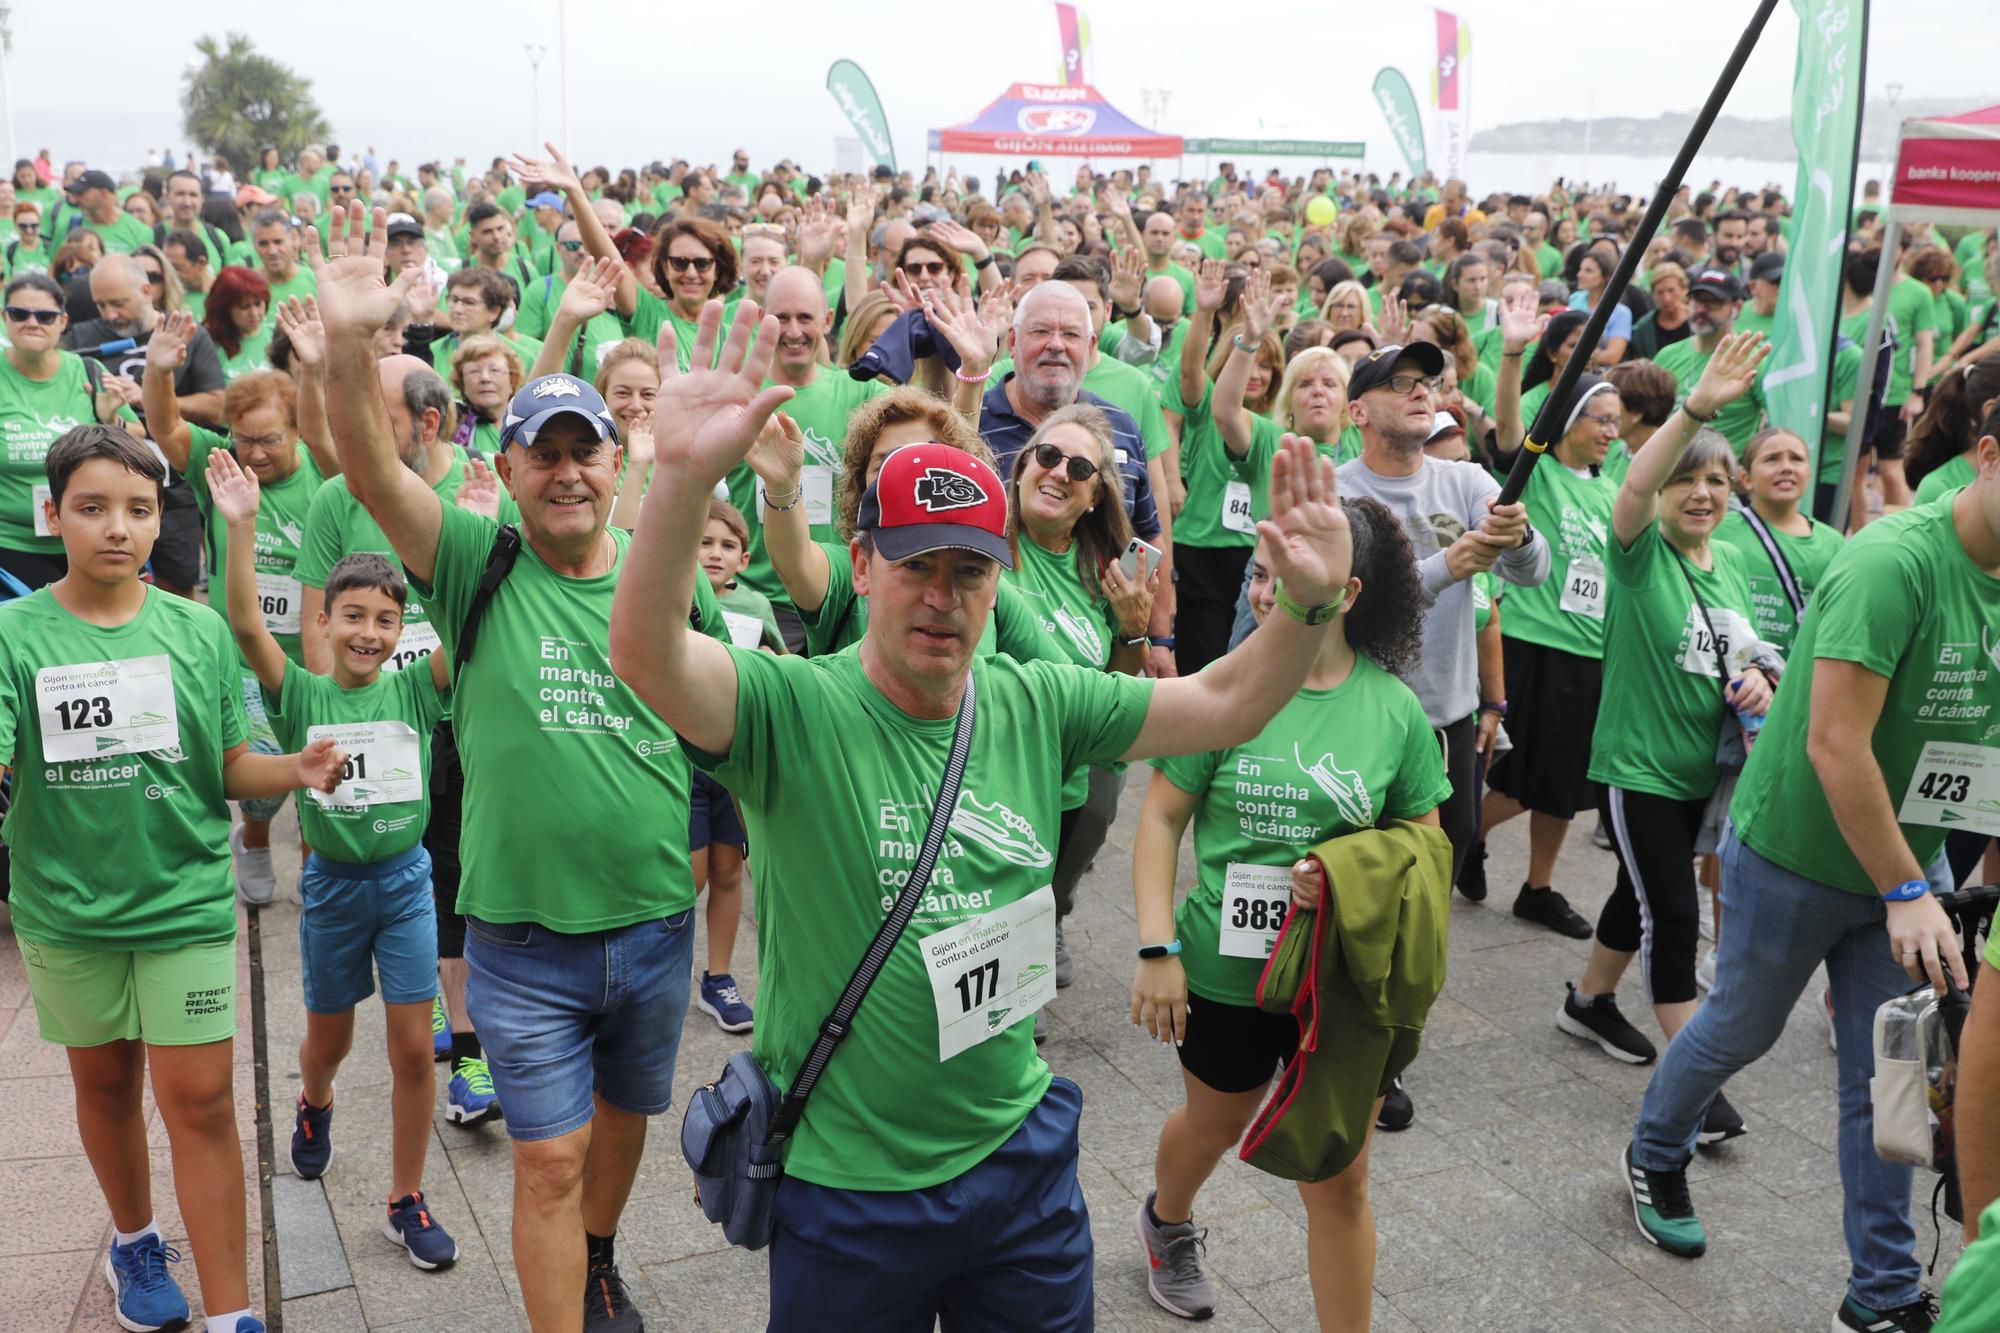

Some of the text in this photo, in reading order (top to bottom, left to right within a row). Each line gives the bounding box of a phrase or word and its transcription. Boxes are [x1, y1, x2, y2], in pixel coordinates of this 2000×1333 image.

[1908, 165, 1948, 180] banka
[532, 377, 581, 396] NEVADA
[6, 429, 52, 441] marcha
[8, 441, 48, 451] contra
[23, 449, 47, 460] cán
[932, 477, 974, 503] KC
[1230, 499, 1251, 518] 84
[1572, 578, 1598, 599] 420
[541, 640, 568, 660] En
[1939, 647, 1962, 665] En
[43, 674, 68, 686] Gijón
[69, 673, 81, 682] en
[83, 669, 117, 680] marcha
[540, 666, 615, 689] marcha
[1933, 666, 1987, 683] marcha
[44, 678, 119, 692] contra el cáncer
[1926, 687, 1974, 701] contra
[540, 687, 605, 707] contra
[54, 696, 113, 730] 123
[540, 705, 634, 730] el cáncer
[1918, 703, 1991, 718] el cáncer
[45, 763, 142, 782] el cáncer
[1237, 758, 1261, 776] En
[1235, 780, 1309, 801] marcha
[1918, 772, 1971, 803] 423
[1236, 800, 1297, 819] contra
[880, 806, 910, 833] En
[1240, 816, 1252, 831] el
[1255, 819, 1322, 839] cáncer
[1231, 881, 1256, 889] contra
[1267, 882, 1292, 891] cánce
[1232, 871, 1251, 880] Gijón
[1264, 873, 1292, 882] march
[914, 889, 993, 914] cáncer
[1232, 897, 1287, 931] 383
[931, 920, 1008, 957] Gijón en marcha
[935, 931, 1010, 968] contra el cáncer
[187, 985, 231, 999] STREET
[954, 958, 1000, 1013] 177
[184, 1003, 228, 1016] TRICKS
[185, 998, 219, 1007] REAL
